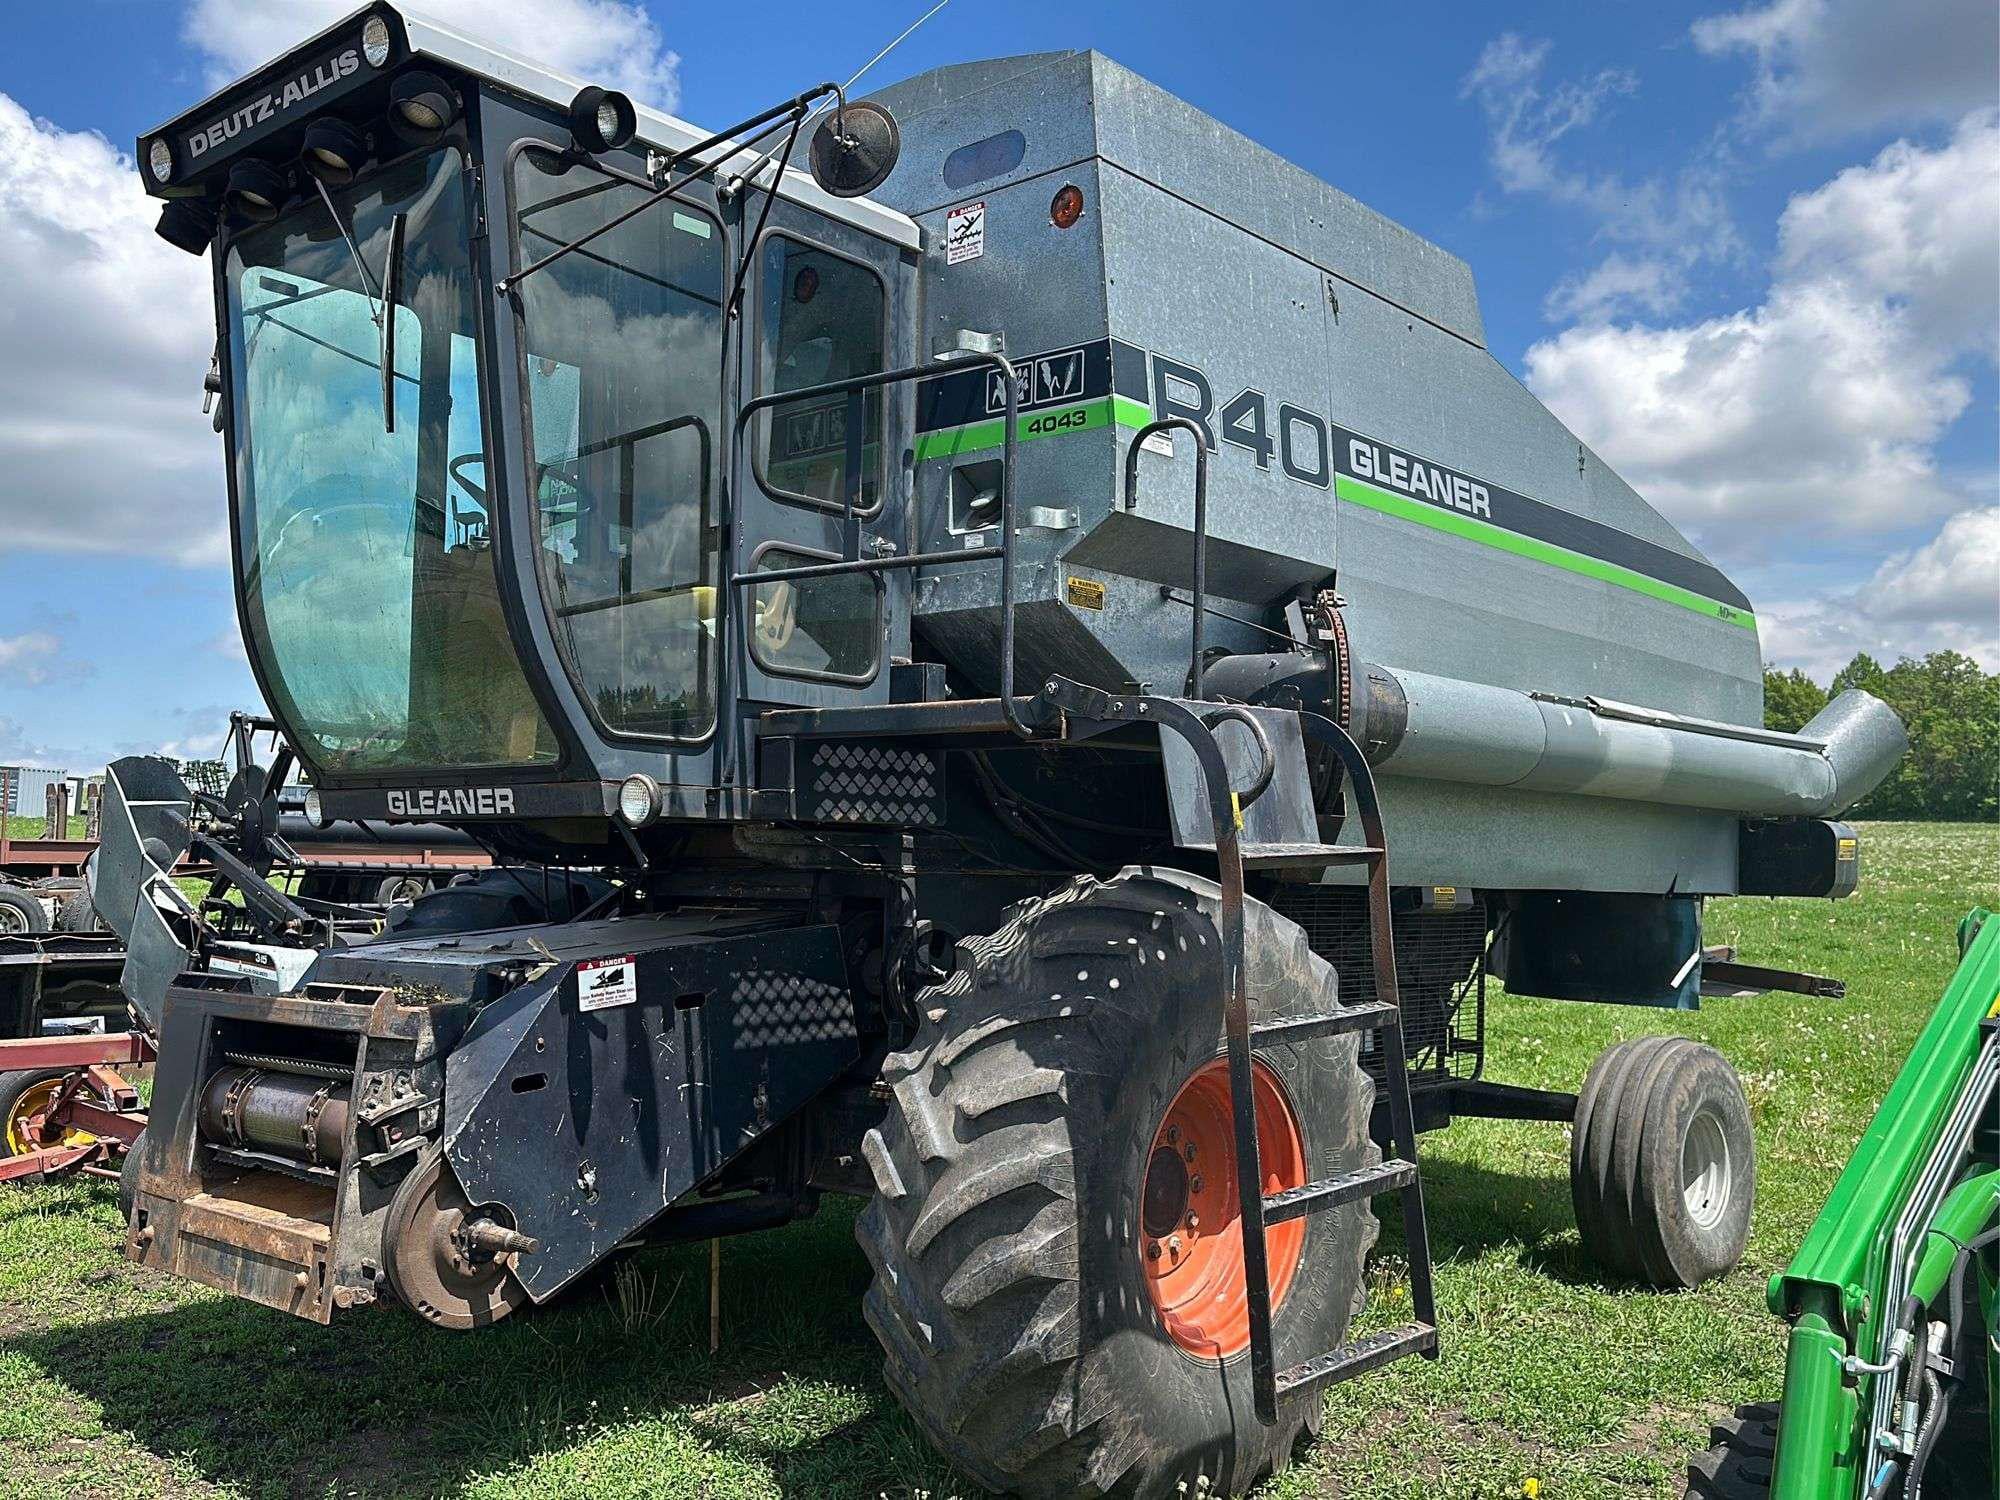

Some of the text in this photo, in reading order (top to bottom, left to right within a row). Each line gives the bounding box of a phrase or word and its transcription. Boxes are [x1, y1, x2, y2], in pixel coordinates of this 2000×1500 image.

[188, 49, 360, 159] DEUTZ-ALLIS
[1027, 410, 1087, 434] 4043
[1151, 350, 1331, 490] R40
[1349, 438, 1492, 519] GLEANER
[386, 787, 516, 815] GLEANER
[599, 957, 627, 967] DANGER
